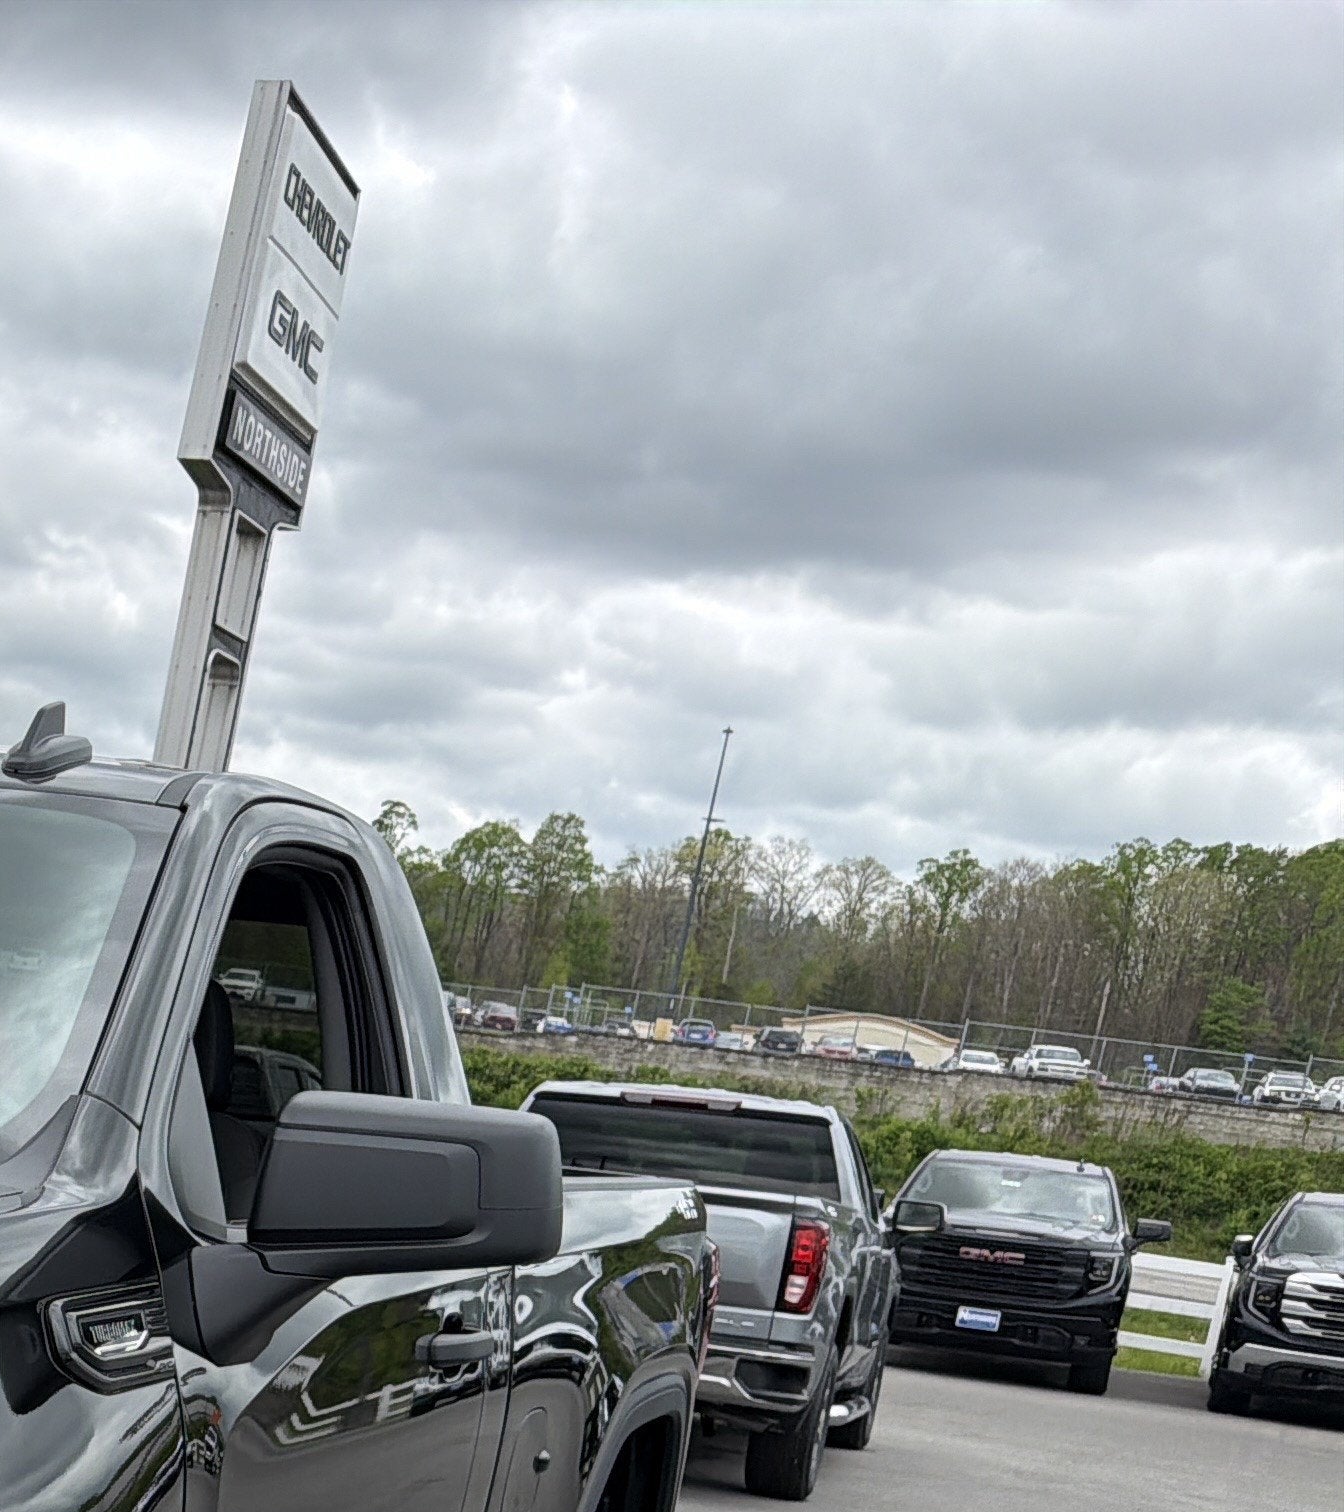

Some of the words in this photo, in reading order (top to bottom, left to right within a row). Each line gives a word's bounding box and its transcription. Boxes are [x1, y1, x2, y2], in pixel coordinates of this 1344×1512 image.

[283, 161, 351, 276] CHEVROLET
[267, 289, 325, 385] GMC
[233, 404, 308, 496] NORTHSIDE
[959, 1246, 1026, 1266] GMC
